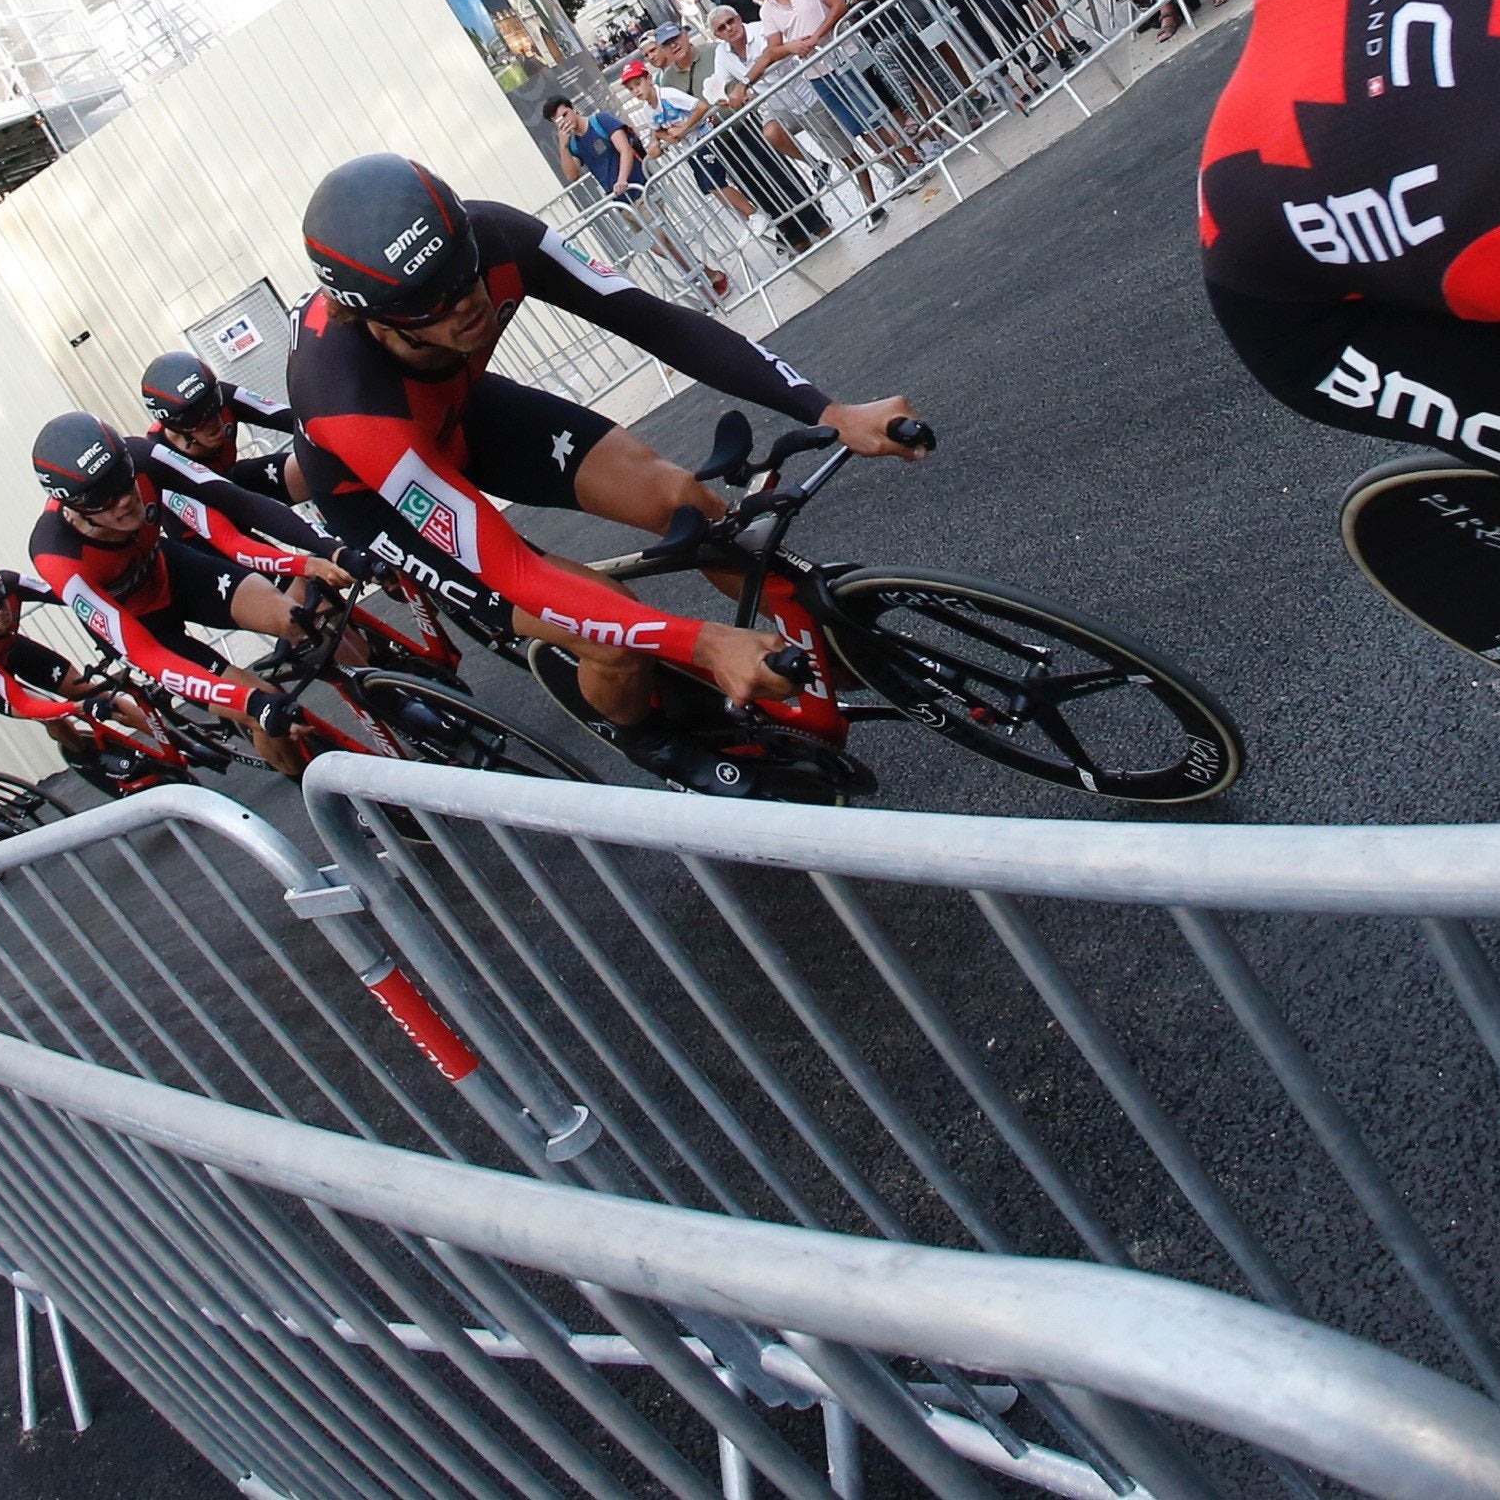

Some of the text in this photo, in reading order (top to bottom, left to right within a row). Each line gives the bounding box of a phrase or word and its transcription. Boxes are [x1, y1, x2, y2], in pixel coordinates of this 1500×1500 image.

[1283, 164, 1444, 265] BMC
[384, 217, 429, 264] BMC
[402, 236, 444, 276] GIRO
[176, 373, 200, 393] BMC
[76, 442, 104, 469] BMC
[87, 452, 112, 476] GIRO
[404, 490, 435, 526] AG
[236, 552, 295, 573] BMC
[369, 531, 477, 610] BMC
[775, 547, 814, 573] BMC
[540, 607, 668, 651] BMC
[161, 668, 236, 705] BMC
